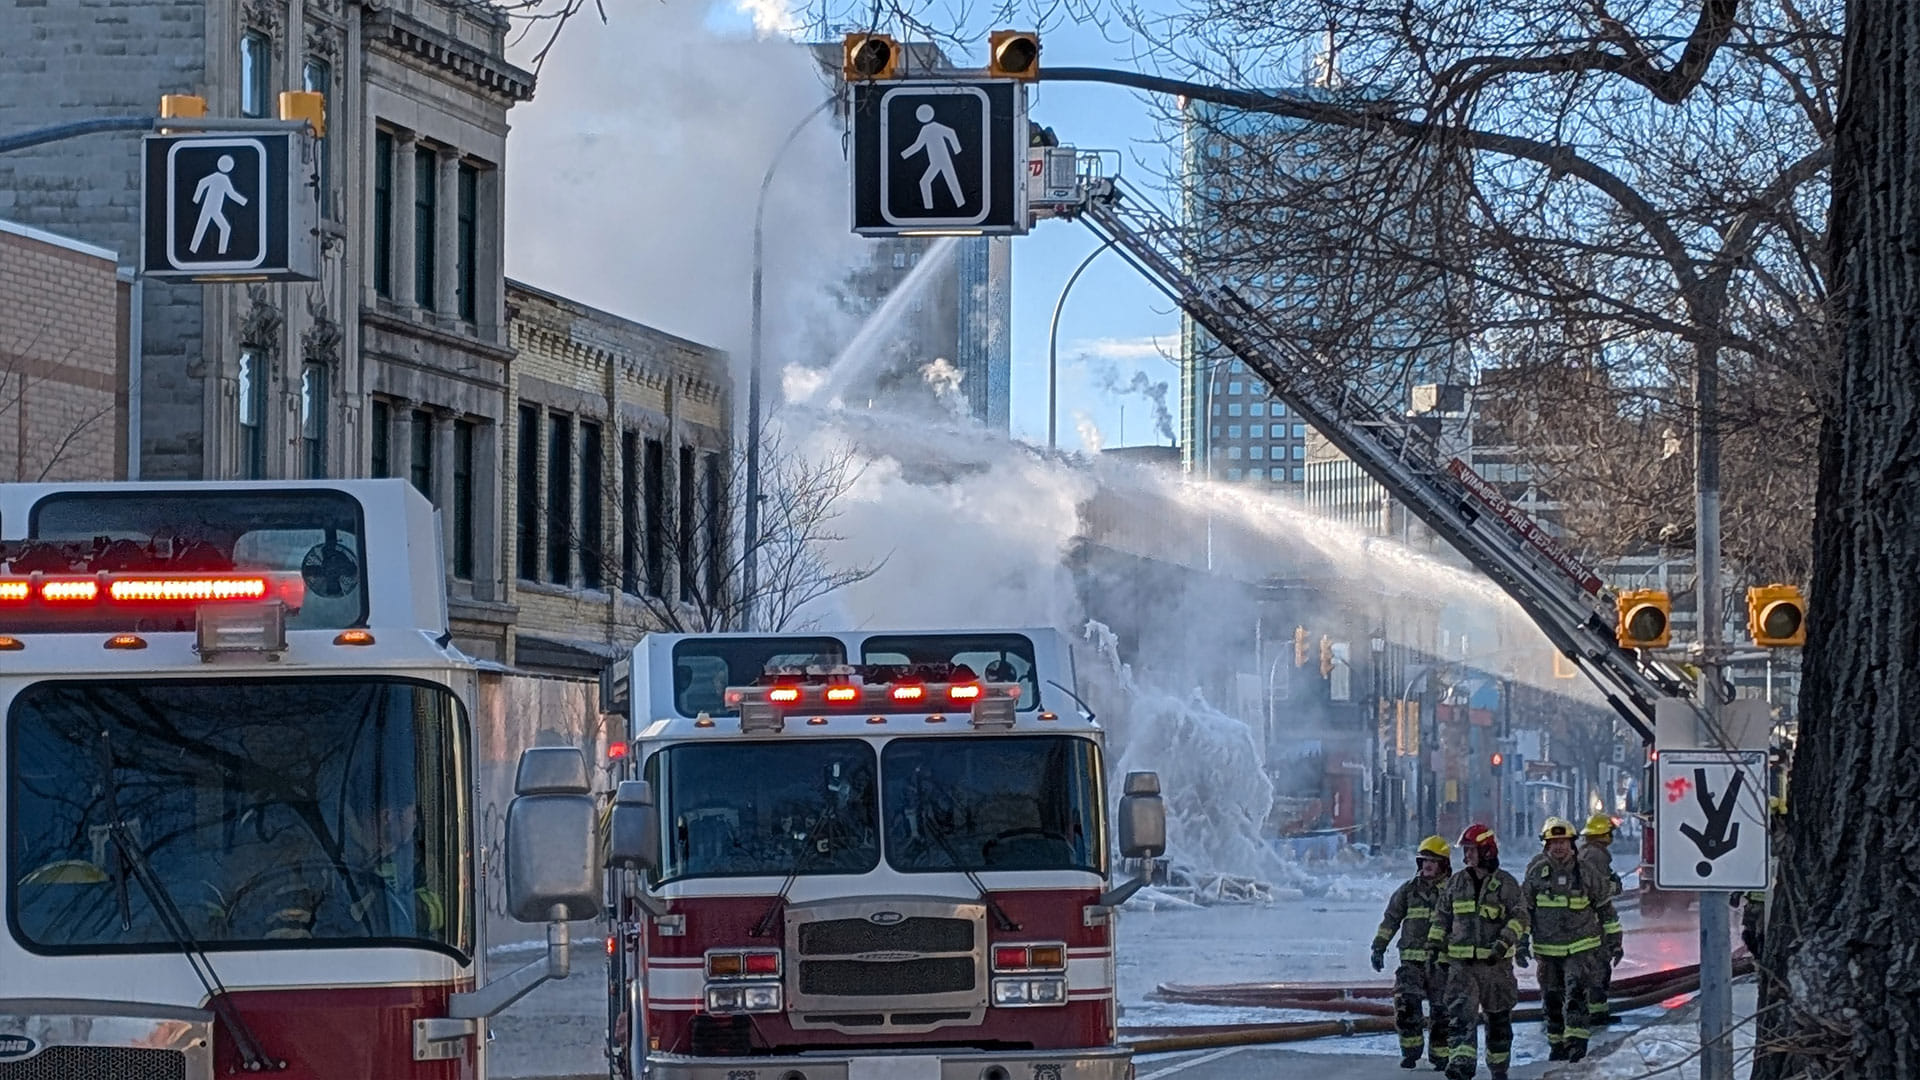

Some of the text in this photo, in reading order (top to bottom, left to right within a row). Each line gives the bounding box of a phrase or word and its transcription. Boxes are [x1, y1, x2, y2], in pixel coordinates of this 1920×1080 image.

[1459, 469, 1593, 585] WINNIPEG FIRE DEPARTMENT
